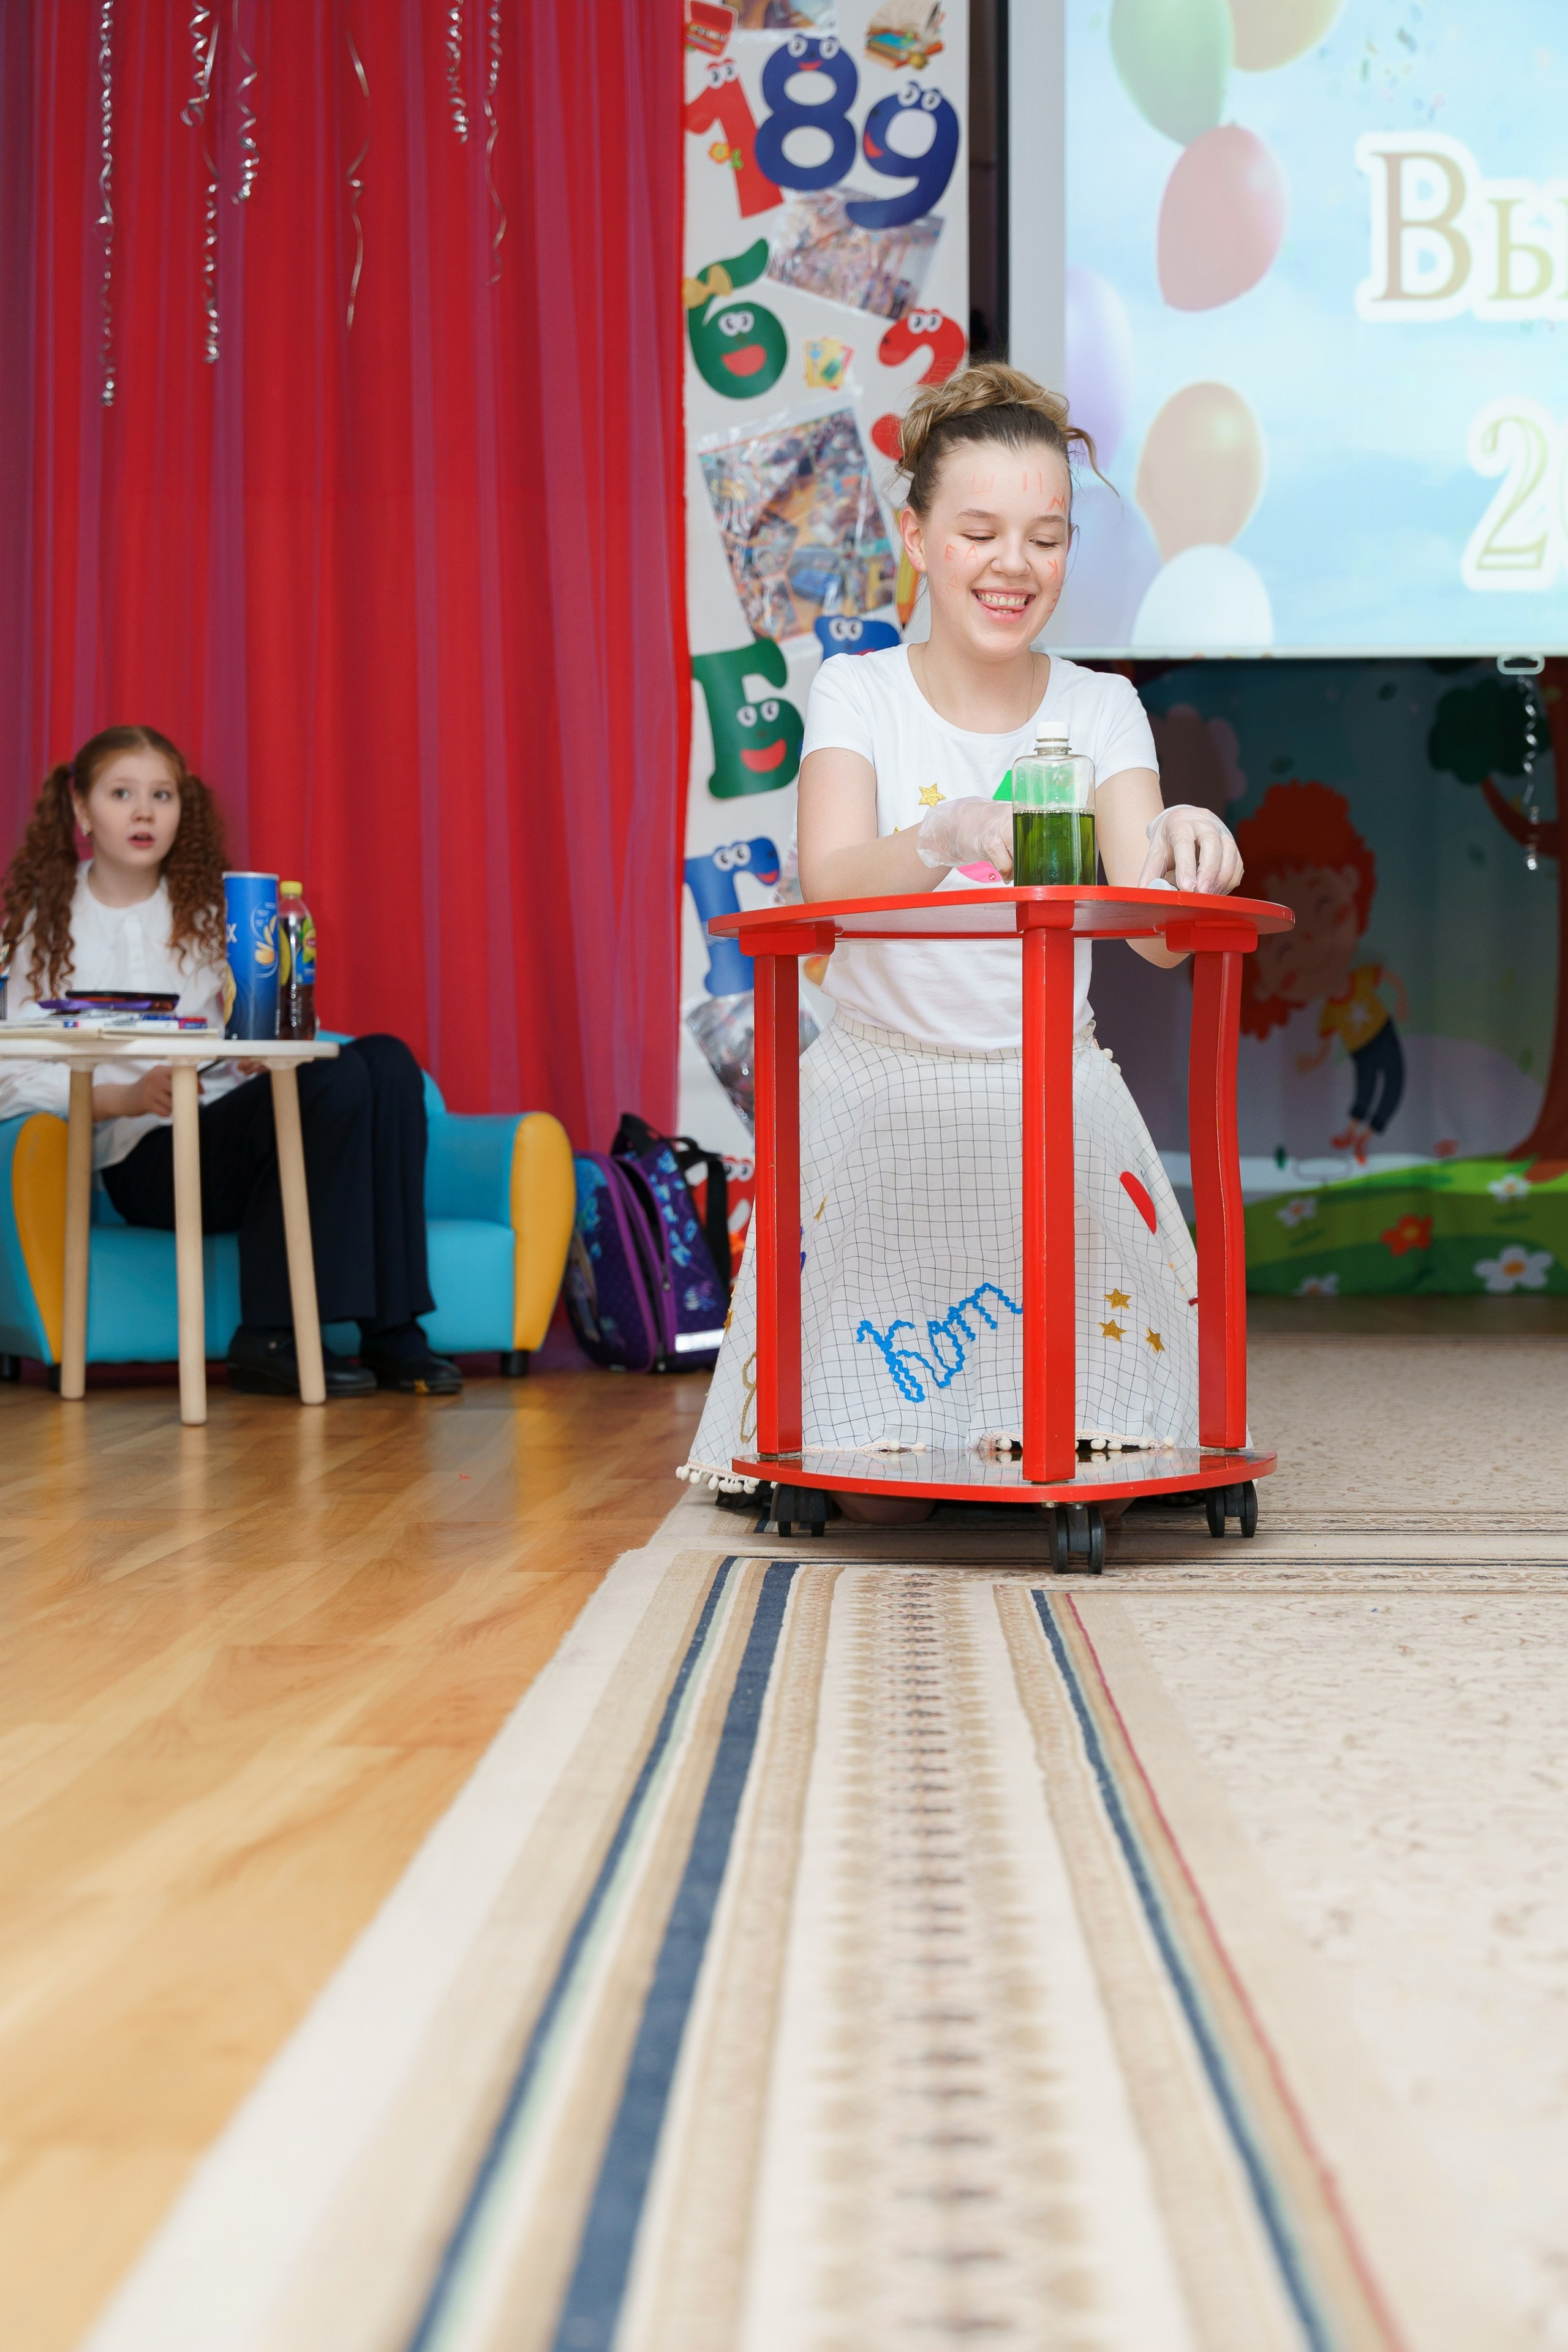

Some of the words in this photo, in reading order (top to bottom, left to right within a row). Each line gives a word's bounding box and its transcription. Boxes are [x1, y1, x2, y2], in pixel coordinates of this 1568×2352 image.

[755, 35, 858, 190] 8
[845, 81, 959, 230] 9
[1477, 415, 1568, 570] 2
[693, 636, 804, 799] Б
